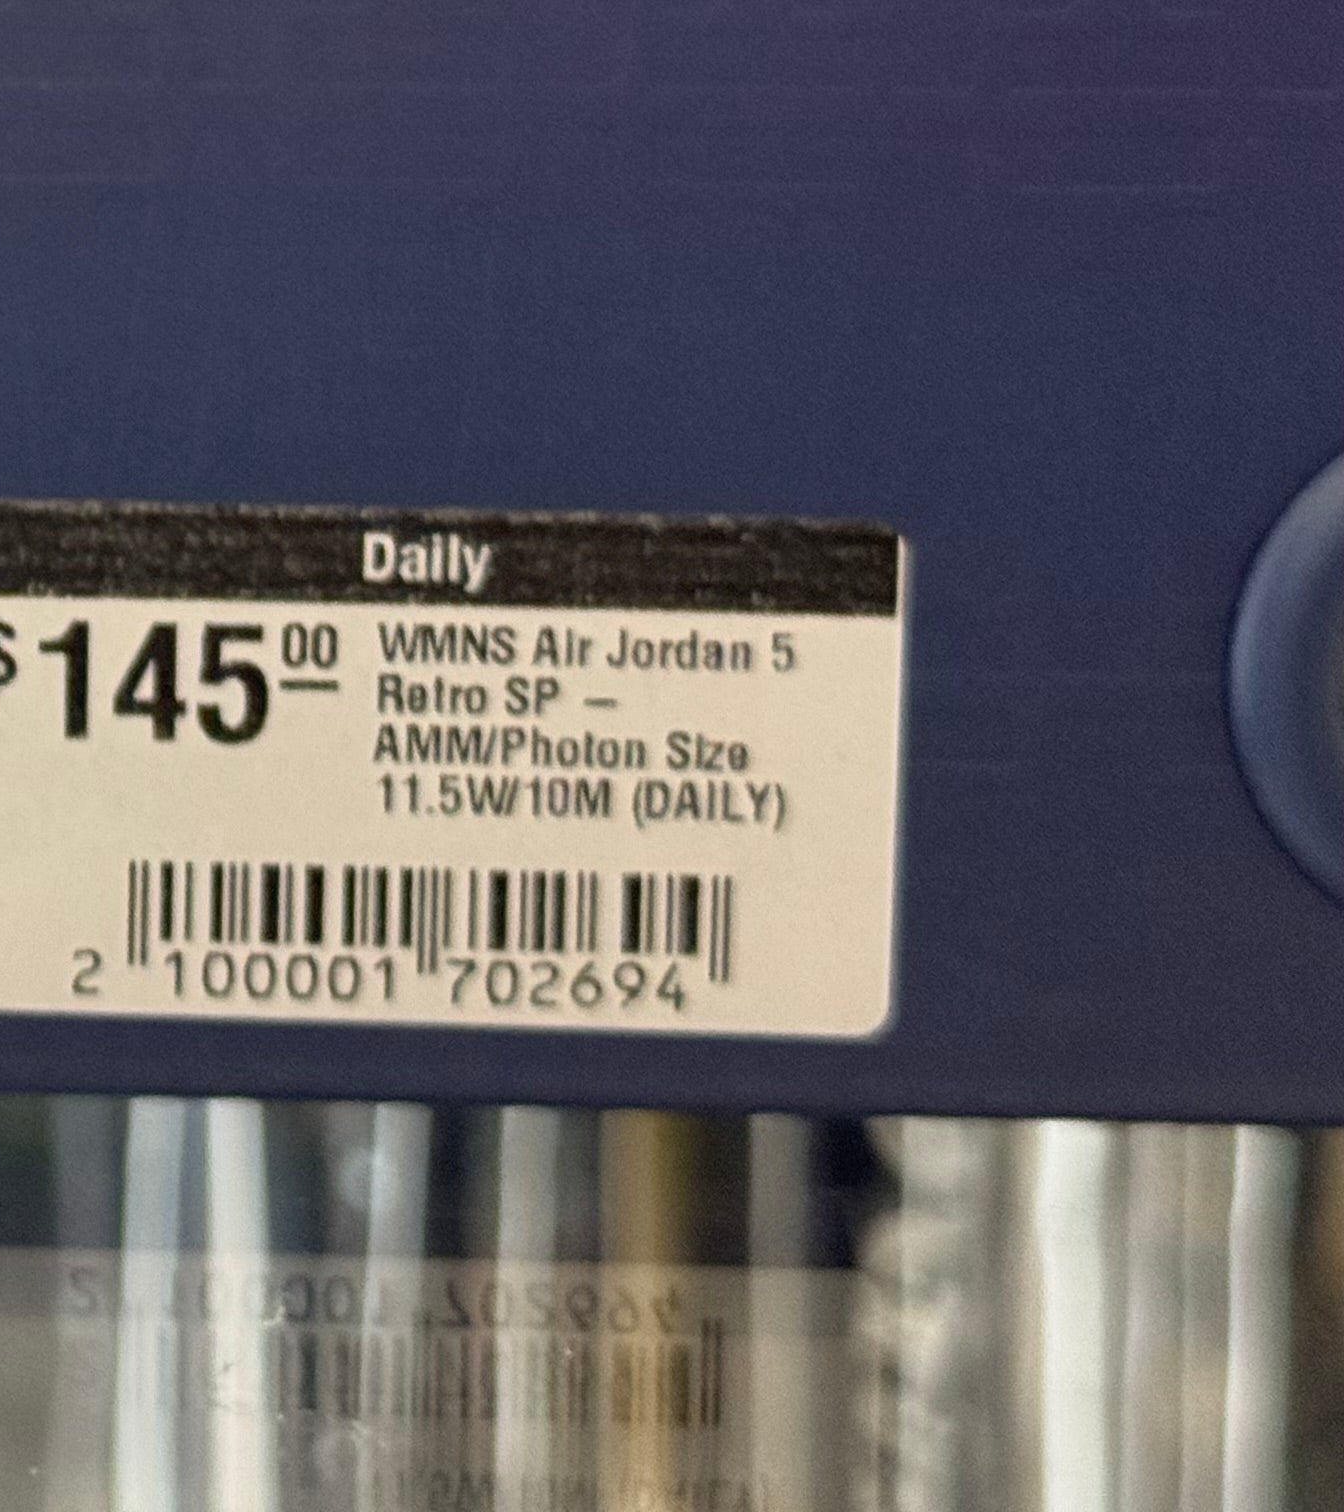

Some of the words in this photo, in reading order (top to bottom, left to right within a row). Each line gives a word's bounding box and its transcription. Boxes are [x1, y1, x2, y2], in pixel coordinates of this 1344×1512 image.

[362, 531, 493, 594] Daily
[378, 622, 517, 666] WMNS
[532, 625, 594, 667] Air
[607, 628, 753, 672] Jordan
[771, 632, 797, 673] 5
[377, 674, 487, 716] Retro
[504, 677, 560, 715] SP
[373, 724, 647, 770] AMM/Photon
[666, 730, 750, 772] Size
[378, 774, 611, 819] 11.5W/10M
[633, 781, 786, 832] (DAILY)
[71, 948, 104, 994] 2
[164, 950, 398, 1003] 100001
[444, 957, 687, 1011] 702694
